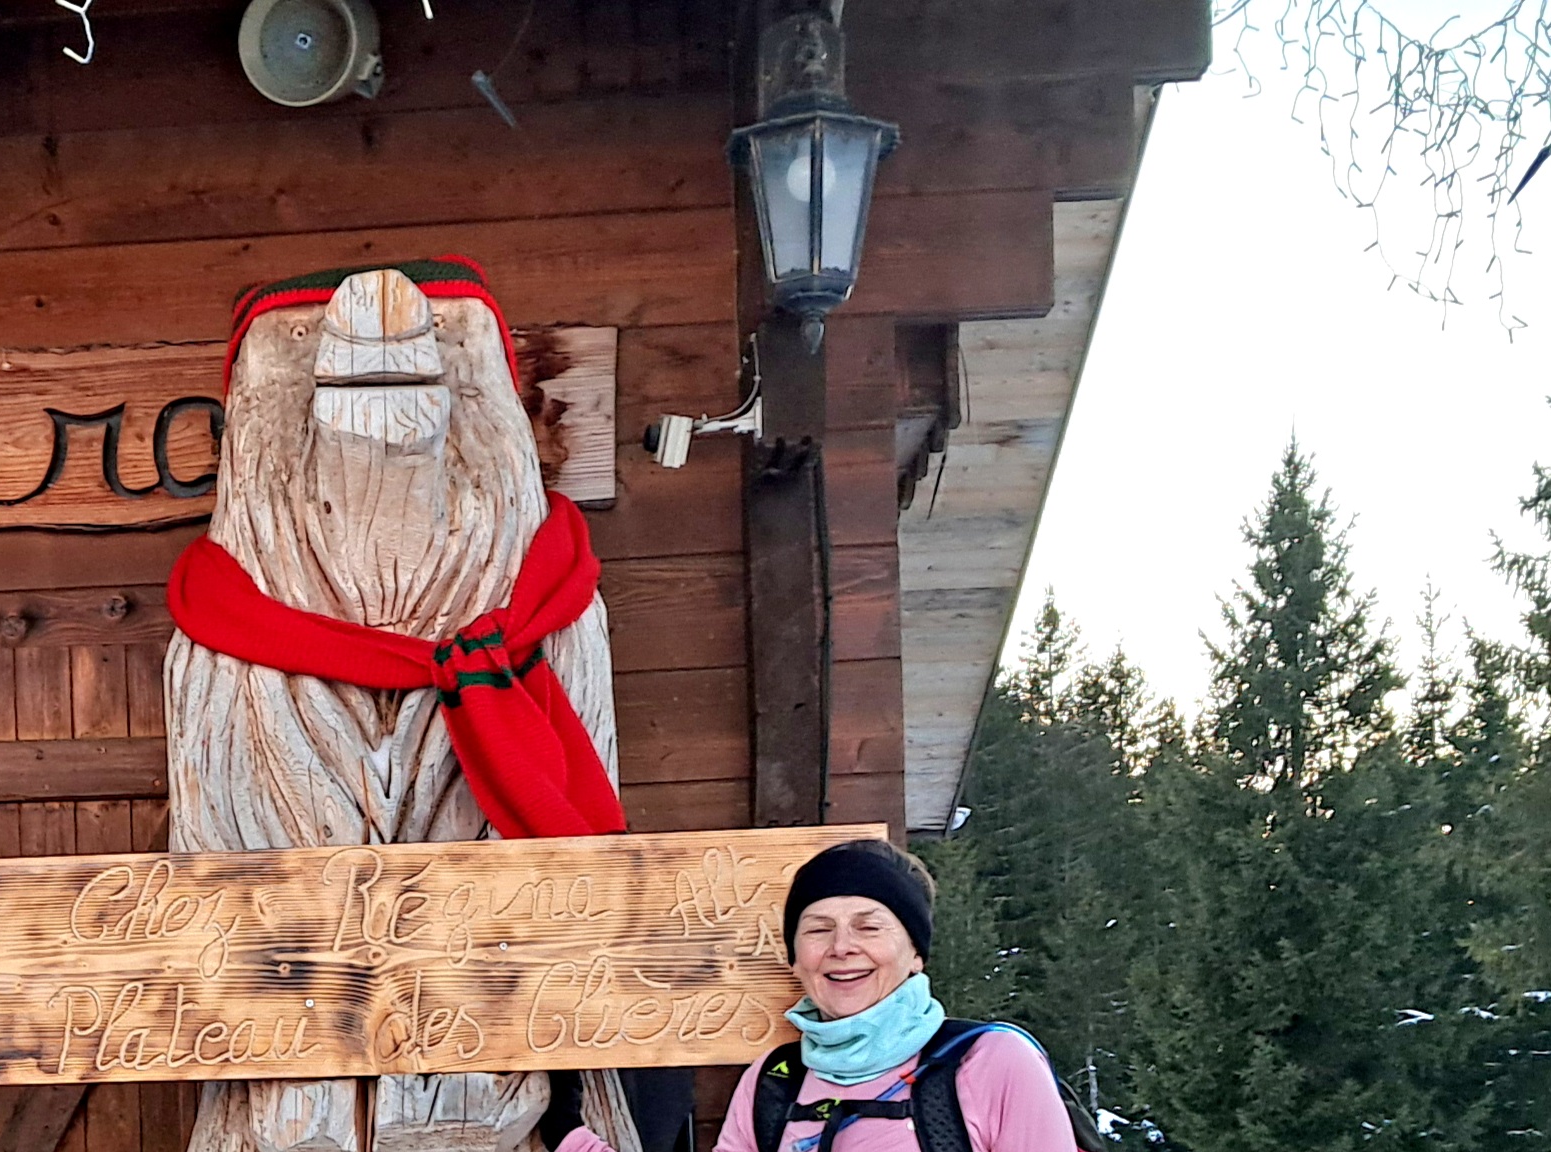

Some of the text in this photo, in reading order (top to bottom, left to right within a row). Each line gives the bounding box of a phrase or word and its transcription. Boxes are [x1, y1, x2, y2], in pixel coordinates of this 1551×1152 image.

[69, 859, 241, 982] Chez
[321, 847, 617, 970] Régina
[48, 981, 321, 1075] Plateau
[374, 970, 485, 1073] des
